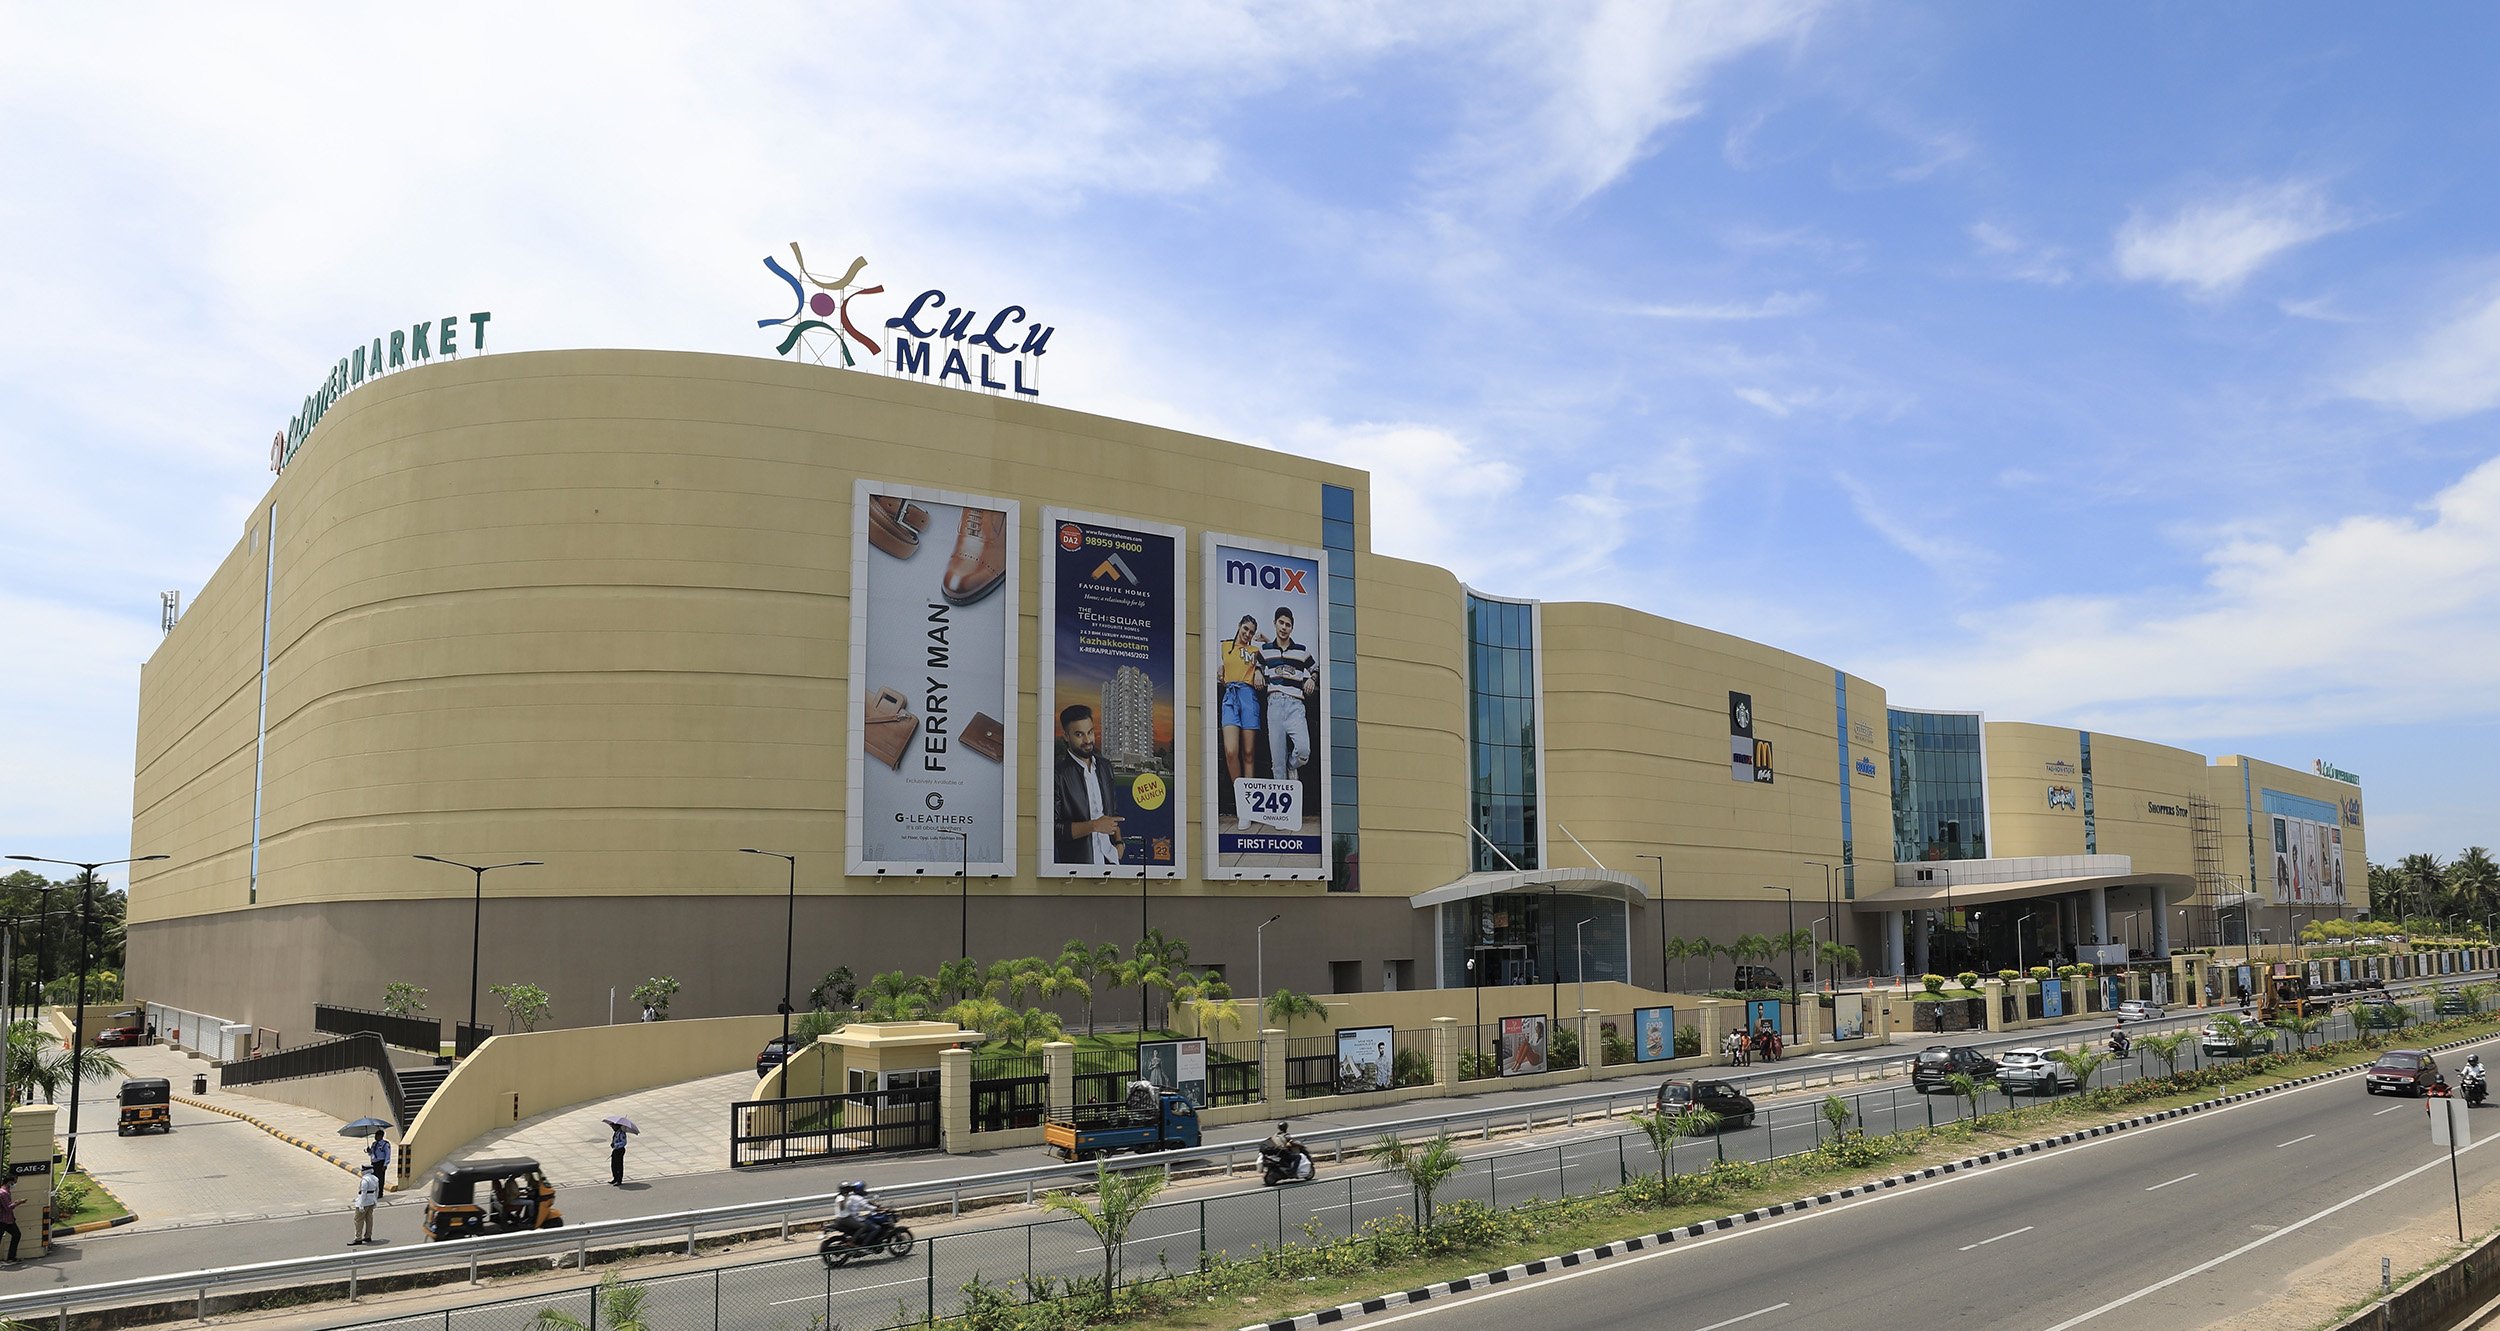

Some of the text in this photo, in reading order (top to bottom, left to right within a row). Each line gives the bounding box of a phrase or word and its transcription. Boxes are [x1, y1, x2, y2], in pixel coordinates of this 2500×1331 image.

[885, 289, 1055, 357] LuLu
[896, 337, 1039, 397] MALL
[1063, 535, 1079, 545] DA2
[1085, 536, 1113, 549] 98959
[1115, 540, 1142, 553] 94000
[1226, 559, 1307, 594] max
[1078, 582, 1151, 598] FAVOURITE HOMES
[1098, 623, 1123, 631] FAVOURITE
[1080, 636, 1149, 651] Kazhakkoottam
[1120, 633, 1149, 642] APARTMENTS
[924, 603, 950, 772] FERRY MAN
[1136, 780, 1158, 795] NEW
[1243, 782, 1294, 791] YOUTH STYLES
[1136, 788, 1165, 804] LAUNCH
[894, 812, 974, 825] G-LEATHERS
[1237, 838, 1303, 850] FIRST FLOOR
[15, 1164, 46, 1173] GATE-2
